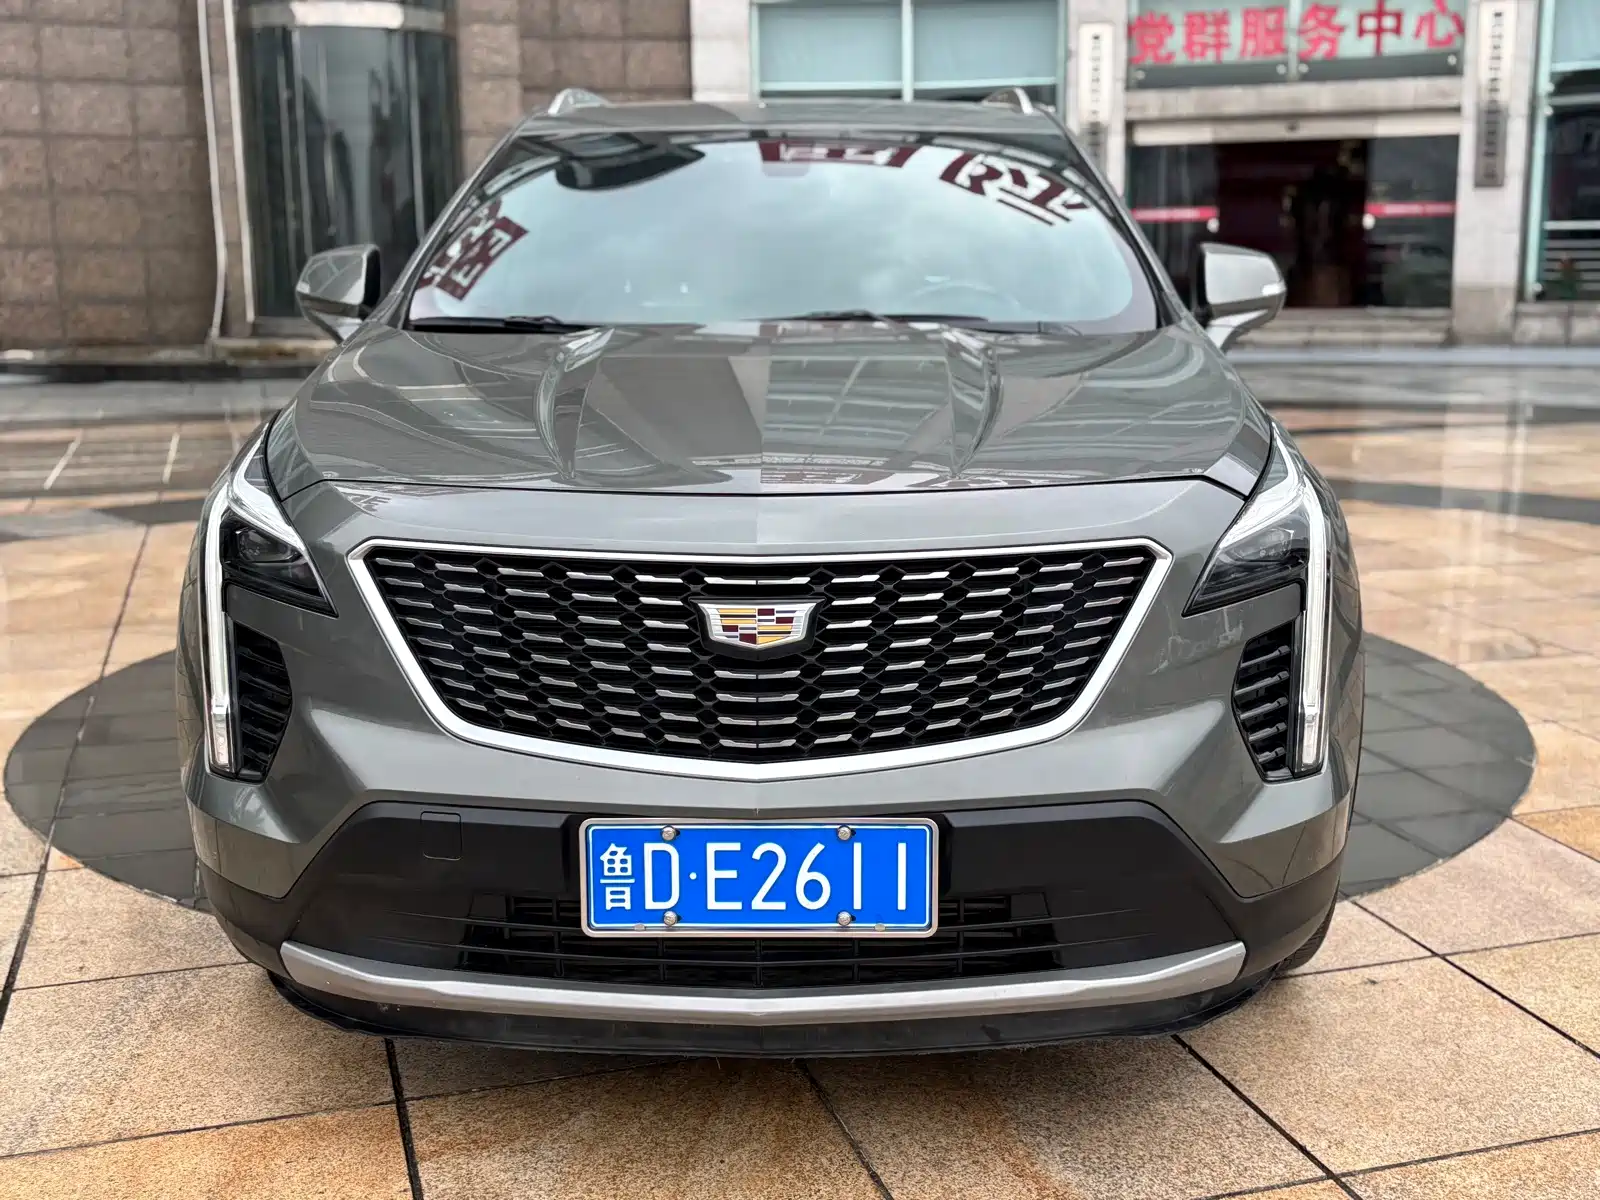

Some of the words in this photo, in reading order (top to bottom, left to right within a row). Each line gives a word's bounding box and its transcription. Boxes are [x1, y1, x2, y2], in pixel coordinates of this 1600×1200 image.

[1128, 0, 1464, 64] 党群服务中心
[600, 842, 907, 911] 鲁D·E2611
